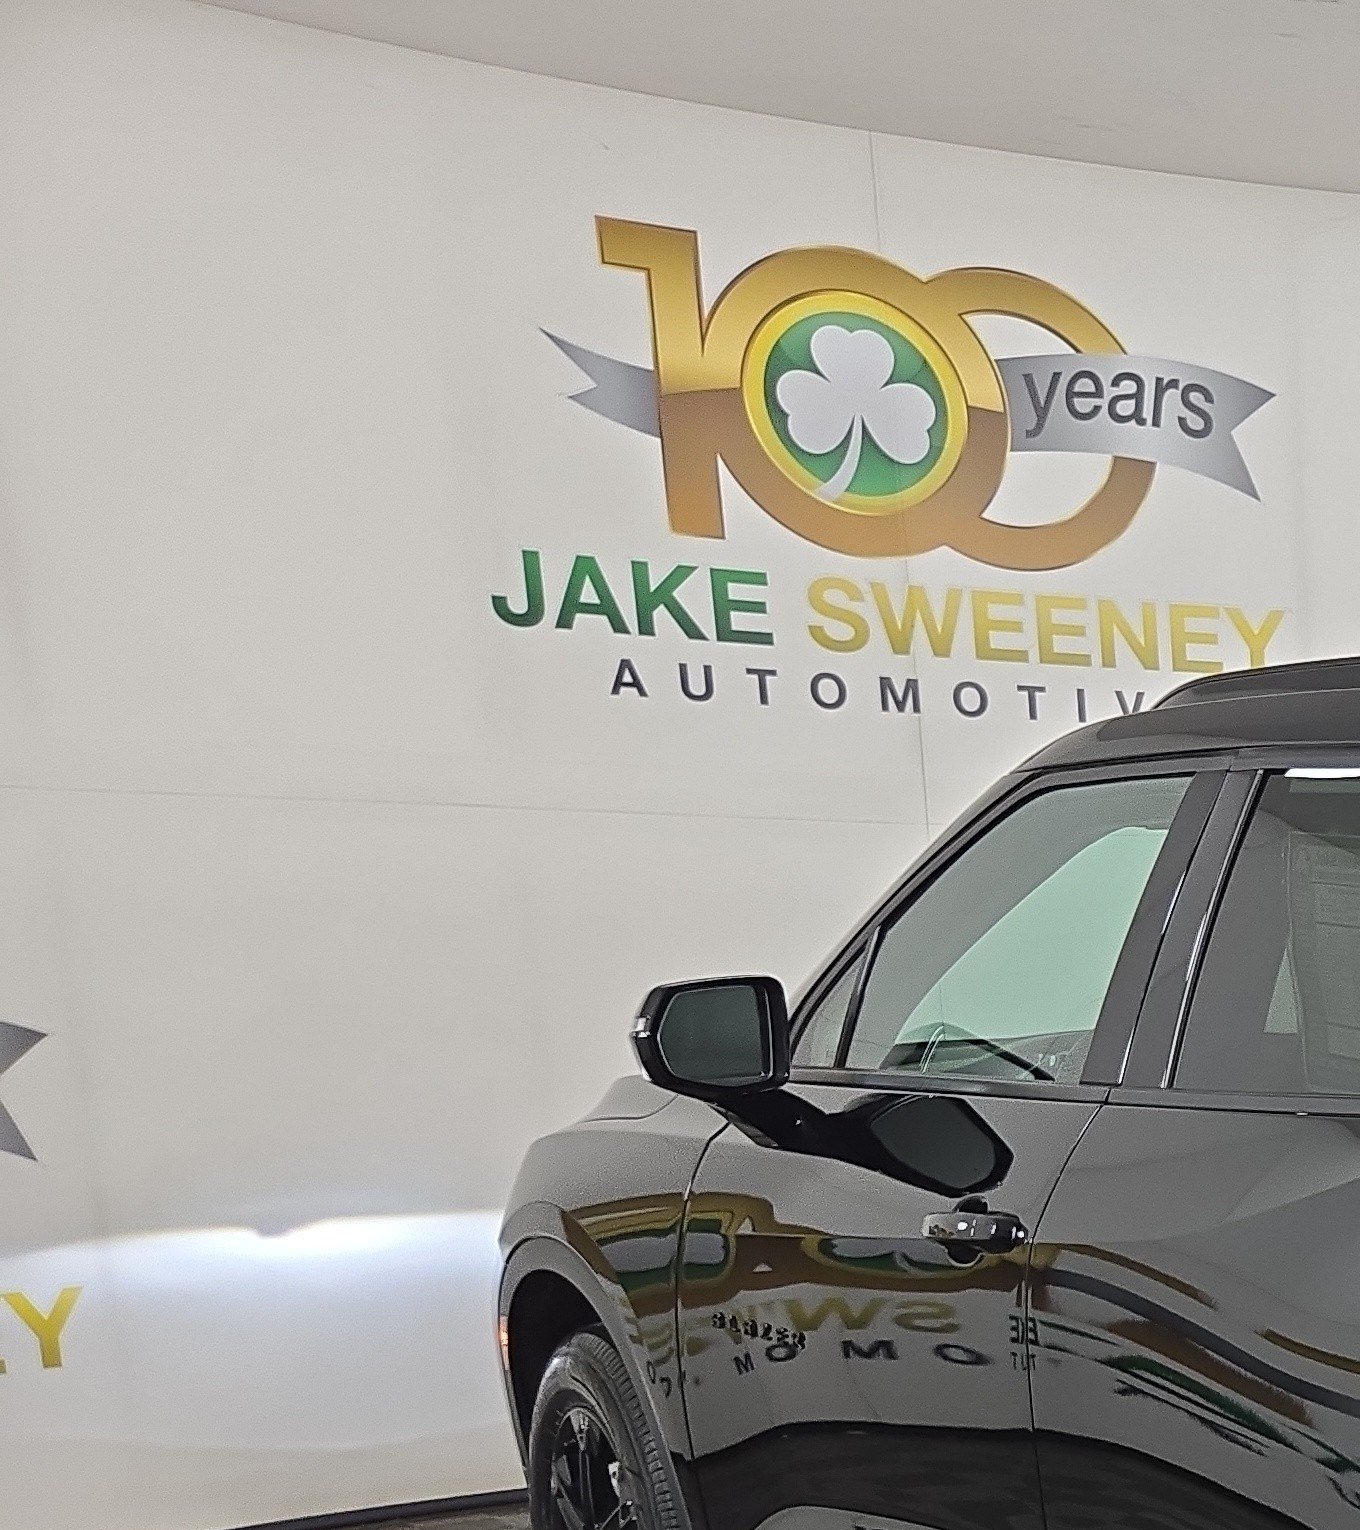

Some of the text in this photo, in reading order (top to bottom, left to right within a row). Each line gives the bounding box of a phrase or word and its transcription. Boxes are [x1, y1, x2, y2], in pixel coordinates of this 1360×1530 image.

[1023, 362, 1216, 441] years
[491, 549, 1285, 674] JAKE SWEENEY
[611, 658, 1146, 724] AUTOMOTIV
